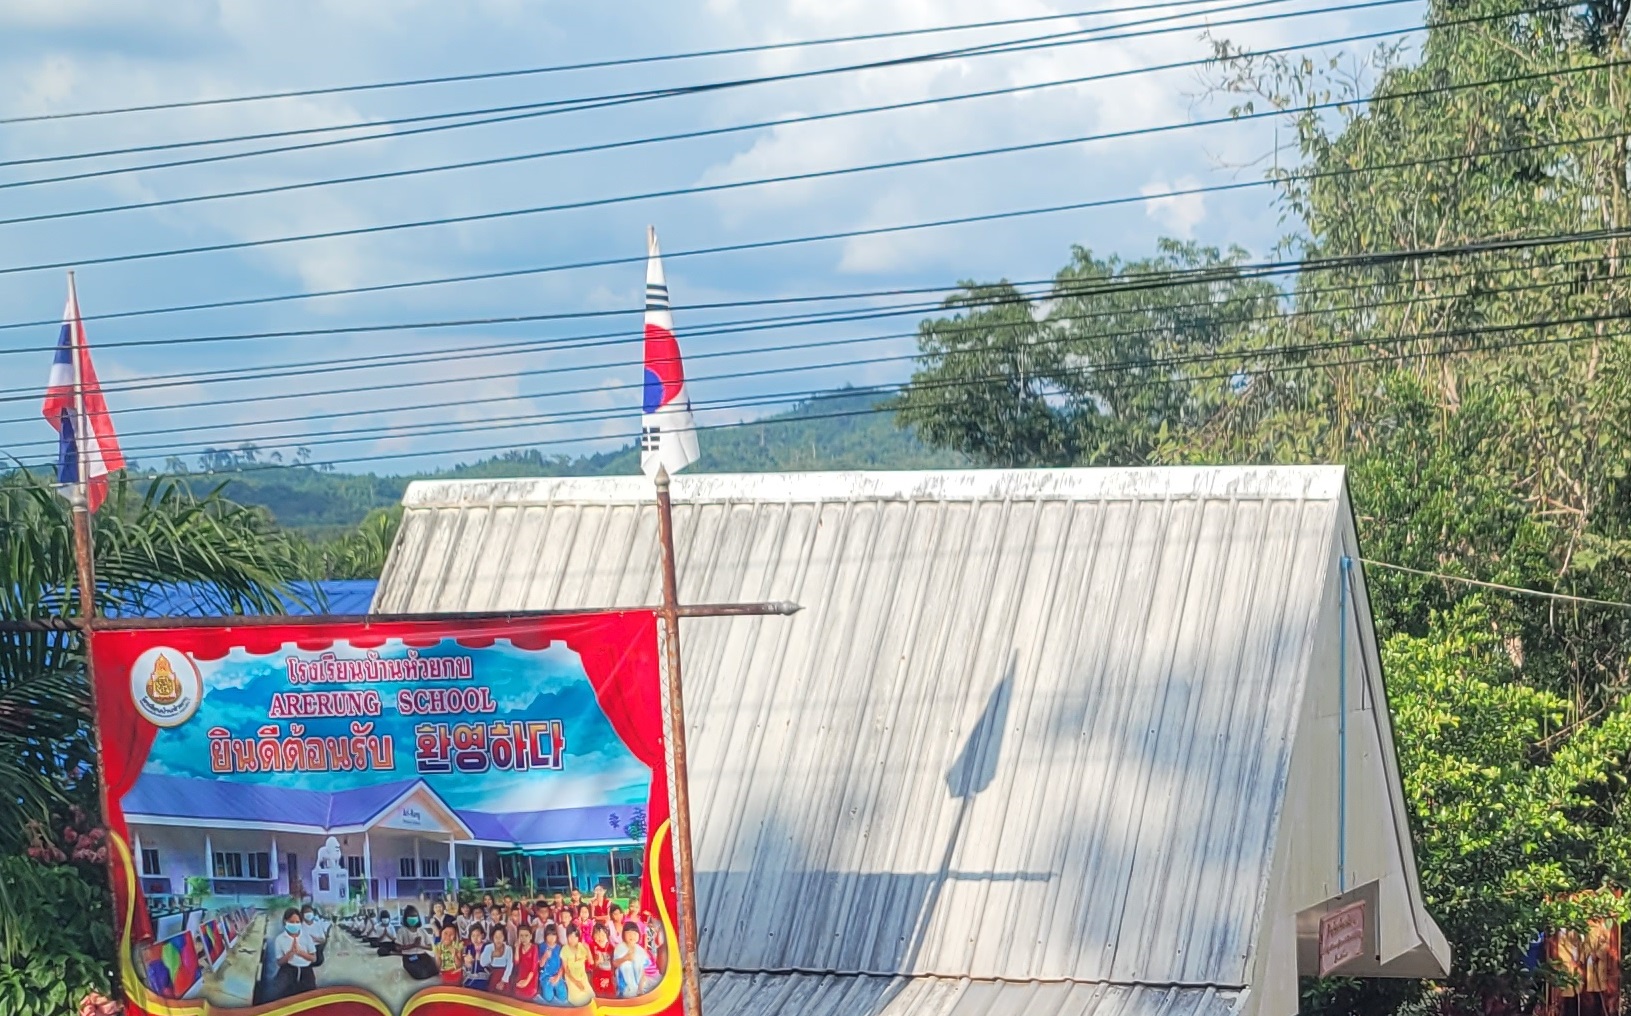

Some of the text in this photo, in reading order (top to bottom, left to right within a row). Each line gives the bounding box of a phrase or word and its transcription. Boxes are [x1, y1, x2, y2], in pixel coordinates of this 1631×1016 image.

[287, 652, 473, 684] โรงเรียนบ้านห้วยกบ
[269, 688, 497, 718] ARERUNG SCHOOL
[208, 721, 395, 774] ยินดีต้อนรับ
[415, 720, 565, 774] 환영하다
